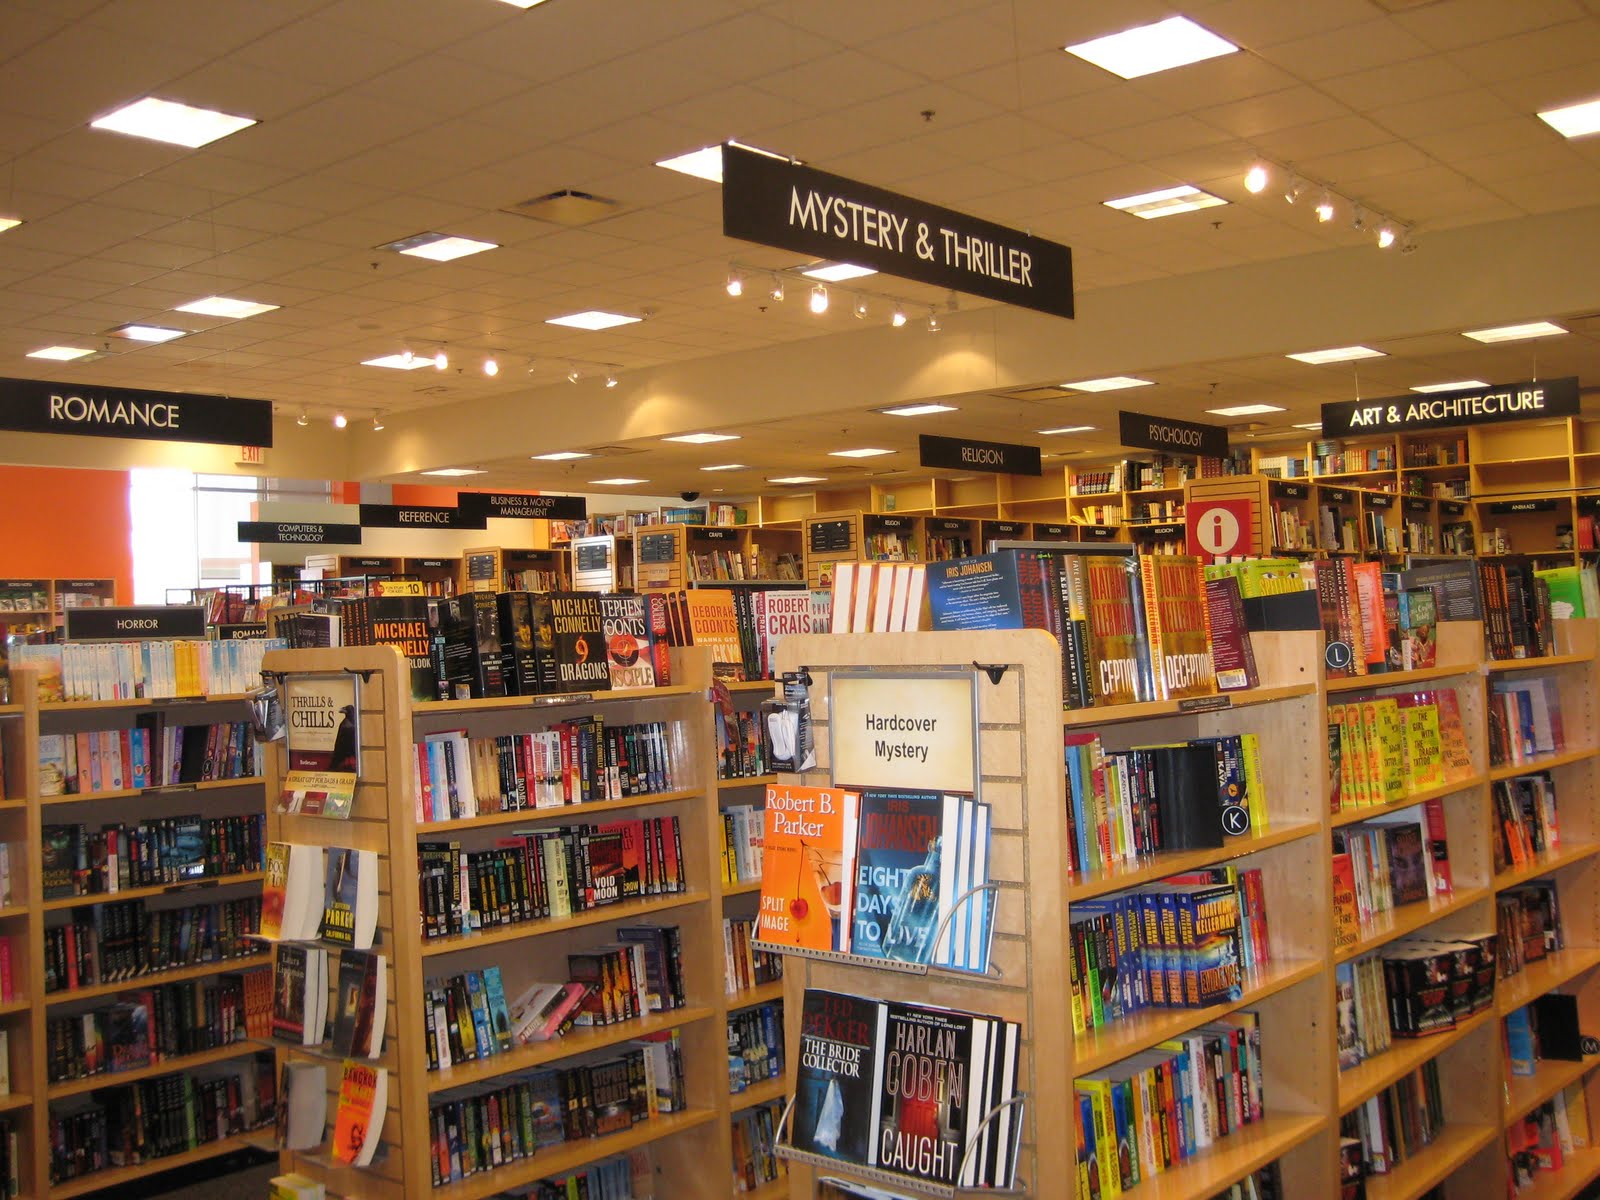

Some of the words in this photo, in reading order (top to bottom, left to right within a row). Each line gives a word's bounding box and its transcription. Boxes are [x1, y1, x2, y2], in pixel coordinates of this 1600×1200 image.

[790, 185, 908, 253] MYSTERY
[916, 223, 935, 262] &
[940, 228, 1033, 287] THRILLER
[50, 395, 179, 428] ROMANCE
[1350, 407, 1382, 427] ART
[1387, 406, 1401, 423] &
[1405, 390, 1545, 422] ARCHITECTURE
[1150, 424, 1203, 448] PSYCHOLOGY
[242, 446, 261, 462] EXIT
[961, 447, 1004, 465] RELIGION
[490, 496, 520, 506] BUSINESS
[522, 498, 528, 506] &
[530, 498, 556, 507] MONEY
[400, 511, 449, 524] REFERENCE
[500, 507, 548, 517] MANAGEMENT
[278, 524, 317, 533] COMPUTERS
[946, 566, 959, 578] IRIS
[960, 562, 993, 576] JOHANSEN
[1060, 572, 1068, 601] KERR
[1090, 566, 1128, 600] NATHAN
[768, 598, 810, 614] ROBERT
[1074, 578, 1084, 615] KELLERMAN
[552, 599, 600, 615] MICHAEL
[600, 600, 642, 617] TEPHEN
[692, 606, 734, 618] DEBORAH
[118, 620, 158, 629] HORROR
[374, 622, 428, 639] MICHAEL
[554, 616, 600, 633] CONNELLY
[695, 620, 736, 634] COONTS
[770, 614, 811, 635] CRAIS
[576, 634, 589, 664] 9
[707, 644, 739, 663] CKY?
[1334, 648, 1343, 662] L
[560, 662, 608, 681] DRAGONS
[1100, 658, 1139, 695] CEPTION
[1166, 652, 1211, 689] DECEPTION
[291, 696, 326, 708] THRILLS
[328, 698, 333, 707] &
[292, 711, 335, 728] CHILLS
[866, 714, 937, 732] Hardcover
[1418, 712, 1428, 721] THE
[1422, 730, 1434, 739] WITH
[875, 741, 928, 763] Mystery
[1414, 756, 1431, 766] TATTOO
[1419, 746, 1440, 758] DRAGON
[1218, 761, 1226, 787] KAVA
[766, 789, 815, 813] Robert
[819, 793, 836, 815] B.
[888, 801, 911, 812] IRIS
[774, 813, 824, 837] Parker
[1230, 812, 1241, 829] K
[863, 814, 937, 852] JOHANSEN
[595, 876, 615, 889] VOID
[860, 866, 909, 888] EIGHT
[594, 887, 618, 900] MOON
[762, 896, 784, 912] SPLIT
[1198, 900, 1233, 919] JONATHAN
[326, 909, 354, 929] PARKER
[762, 913, 789, 932] IMAGE
[1196, 913, 1235, 935] KELLERMAN
[857, 920, 880, 941] TO
[887, 925, 929, 947] LIVE
[1201, 962, 1239, 994] EVIDENCE
[824, 996, 853, 1017] TED
[890, 1014, 916, 1023] BESTSELLING
[803, 1012, 870, 1045] DEKKER
[805, 1038, 826, 1056] THE
[829, 1042, 861, 1063] BRIDE
[896, 1023, 956, 1060] HARLAN
[1585, 1040, 1597, 1052] M
[802, 1053, 860, 1079] COLLECTOR
[886, 1051, 963, 1108] COBEN
[882, 1128, 958, 1180] CAUGHT
